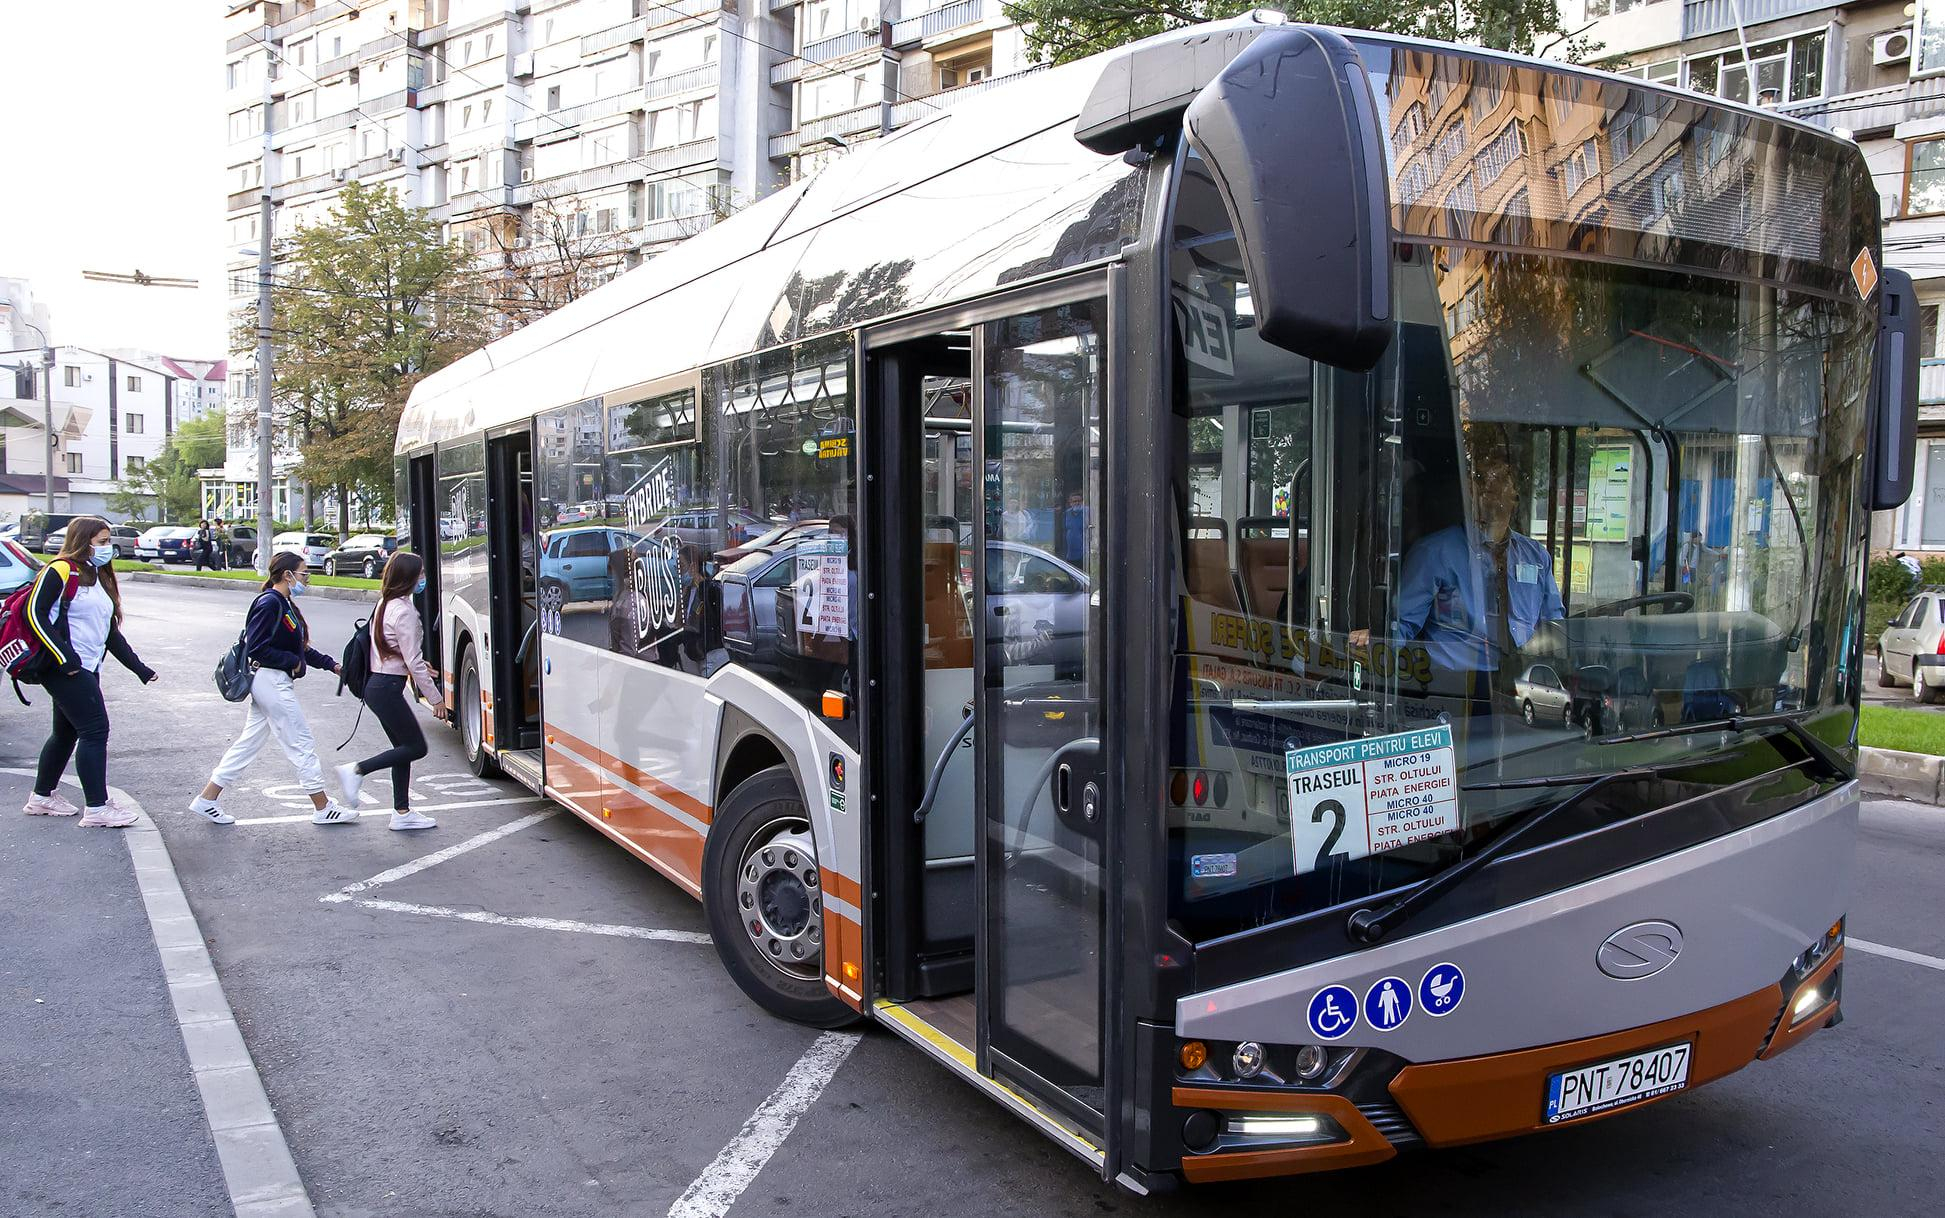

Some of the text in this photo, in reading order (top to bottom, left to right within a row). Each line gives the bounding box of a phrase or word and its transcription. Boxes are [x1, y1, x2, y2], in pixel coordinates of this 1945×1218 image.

[627, 467, 671, 533] HYBRIDE
[633, 535, 677, 640] BUS
[802, 578, 814, 626] 2
[1289, 745, 1356, 770] TRANSPORT
[1361, 738, 1406, 757] PENTRU
[1411, 731, 1442, 749] ELEVI
[1384, 752, 1431, 769] MICRO 19
[1293, 768, 1361, 795] TRASEUL
[1374, 765, 1442, 785] STR. OLTULUI
[1370, 777, 1450, 800] PIATA ENERGIEI
[1386, 793, 1433, 810] MICRO 40
[1387, 805, 1434, 822] MICRO 40
[1311, 799, 1350, 871] 2
[1377, 816, 1445, 836] STR. OLTULUI
[1374, 838, 1402, 852] PIATA
[1549, 1047, 1688, 1110] PL PNT 78407
[1560, 1107, 1588, 1121] SOLARIS
